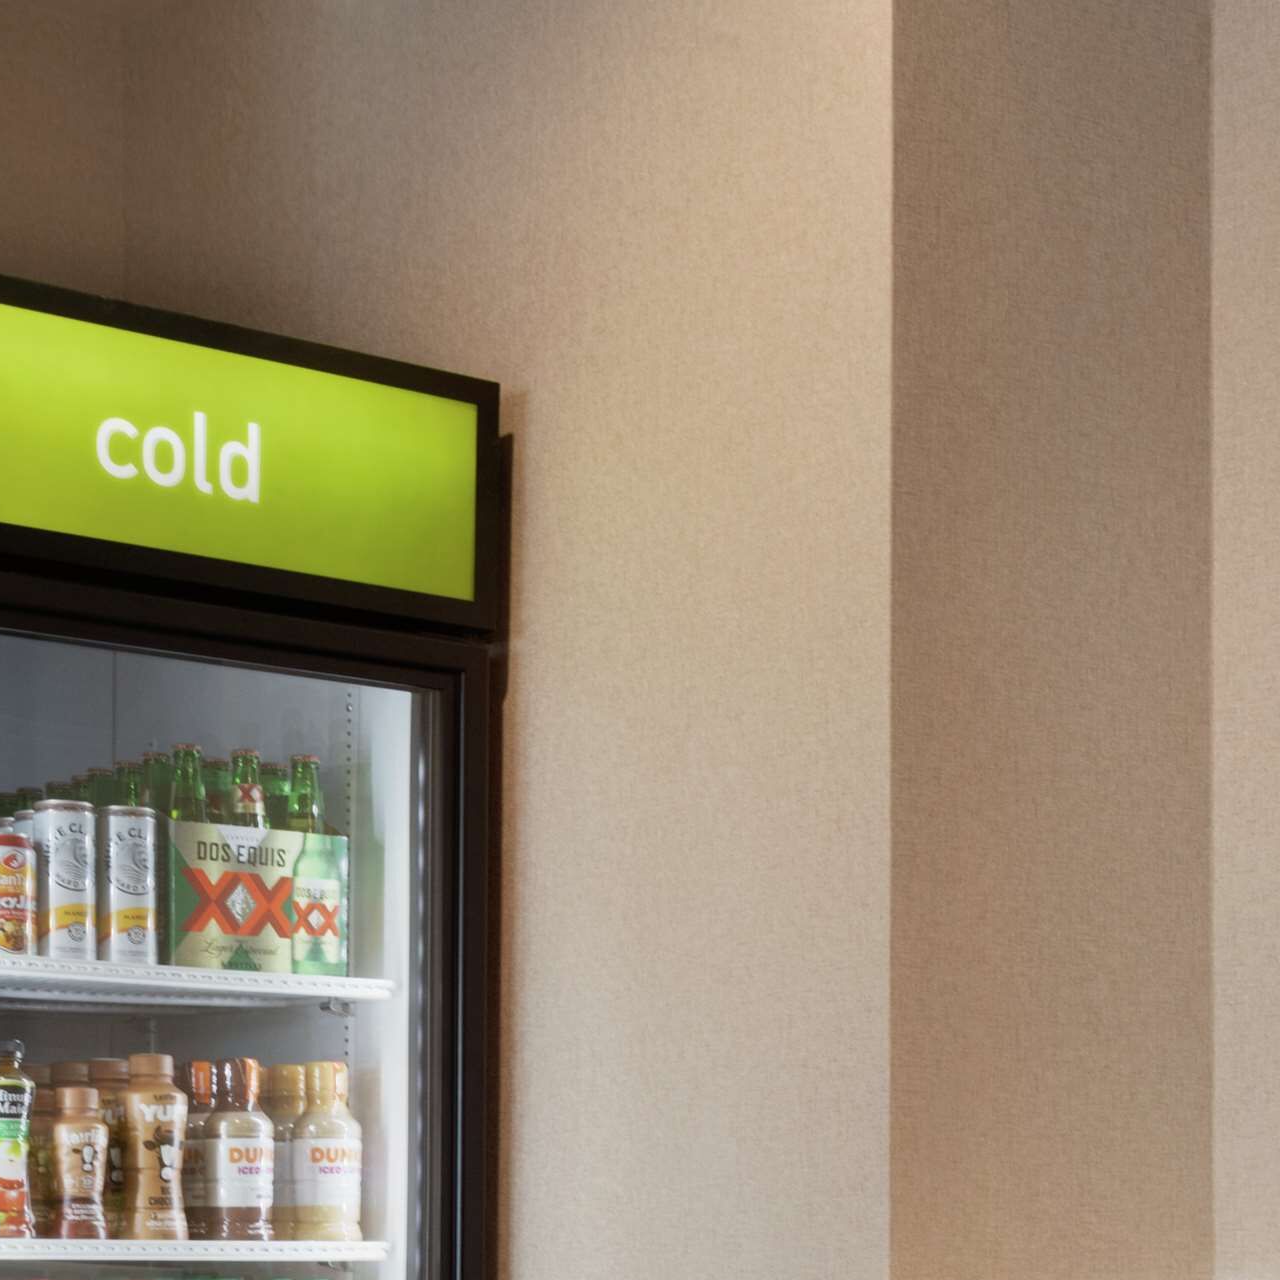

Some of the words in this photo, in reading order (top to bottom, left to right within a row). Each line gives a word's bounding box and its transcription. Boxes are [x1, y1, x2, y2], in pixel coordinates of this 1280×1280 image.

[96, 411, 261, 503] cold
[197, 840, 231, 862] DOS
[237, 844, 286, 868] EQUIS
